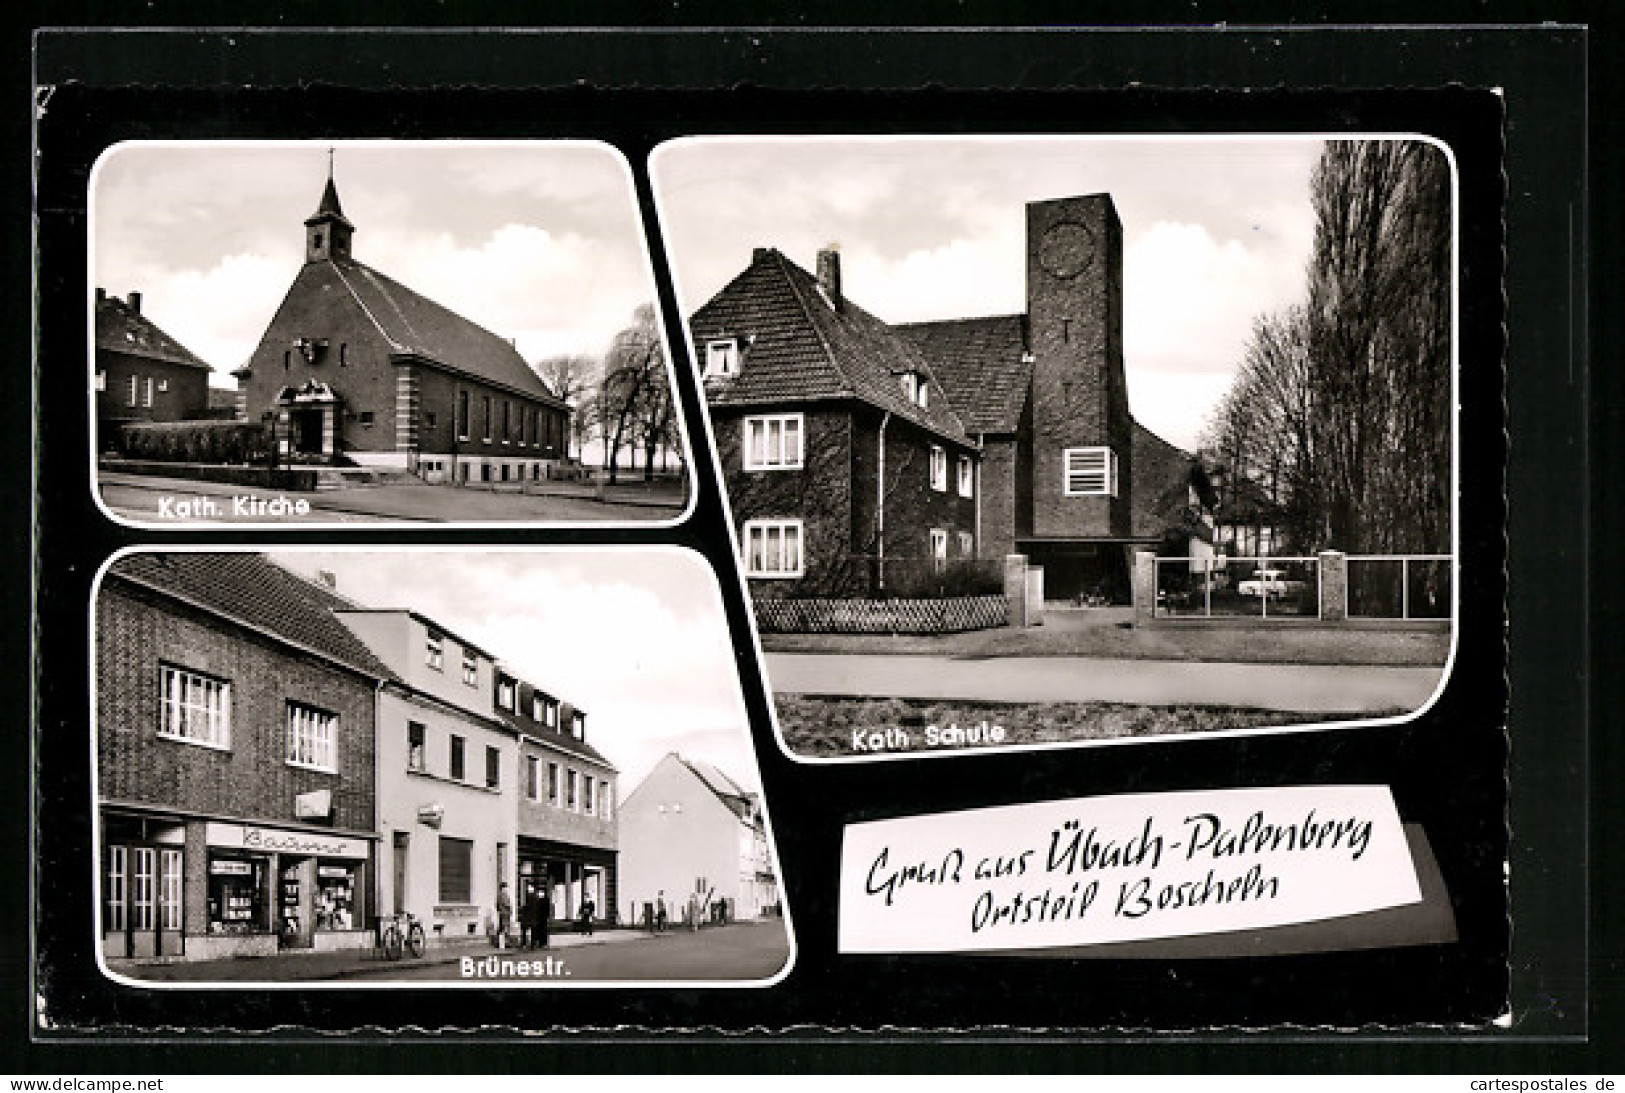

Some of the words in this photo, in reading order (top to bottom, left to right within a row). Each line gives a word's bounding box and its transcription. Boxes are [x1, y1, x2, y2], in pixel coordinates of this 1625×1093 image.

[866, 847, 964, 906] Gruß
[974, 849, 1035, 878] aus
[1046, 808, 1373, 876] Übach-Palenberg
[971, 879, 1100, 933] Ortsteil
[1115, 863, 1280, 918] Boscheln
